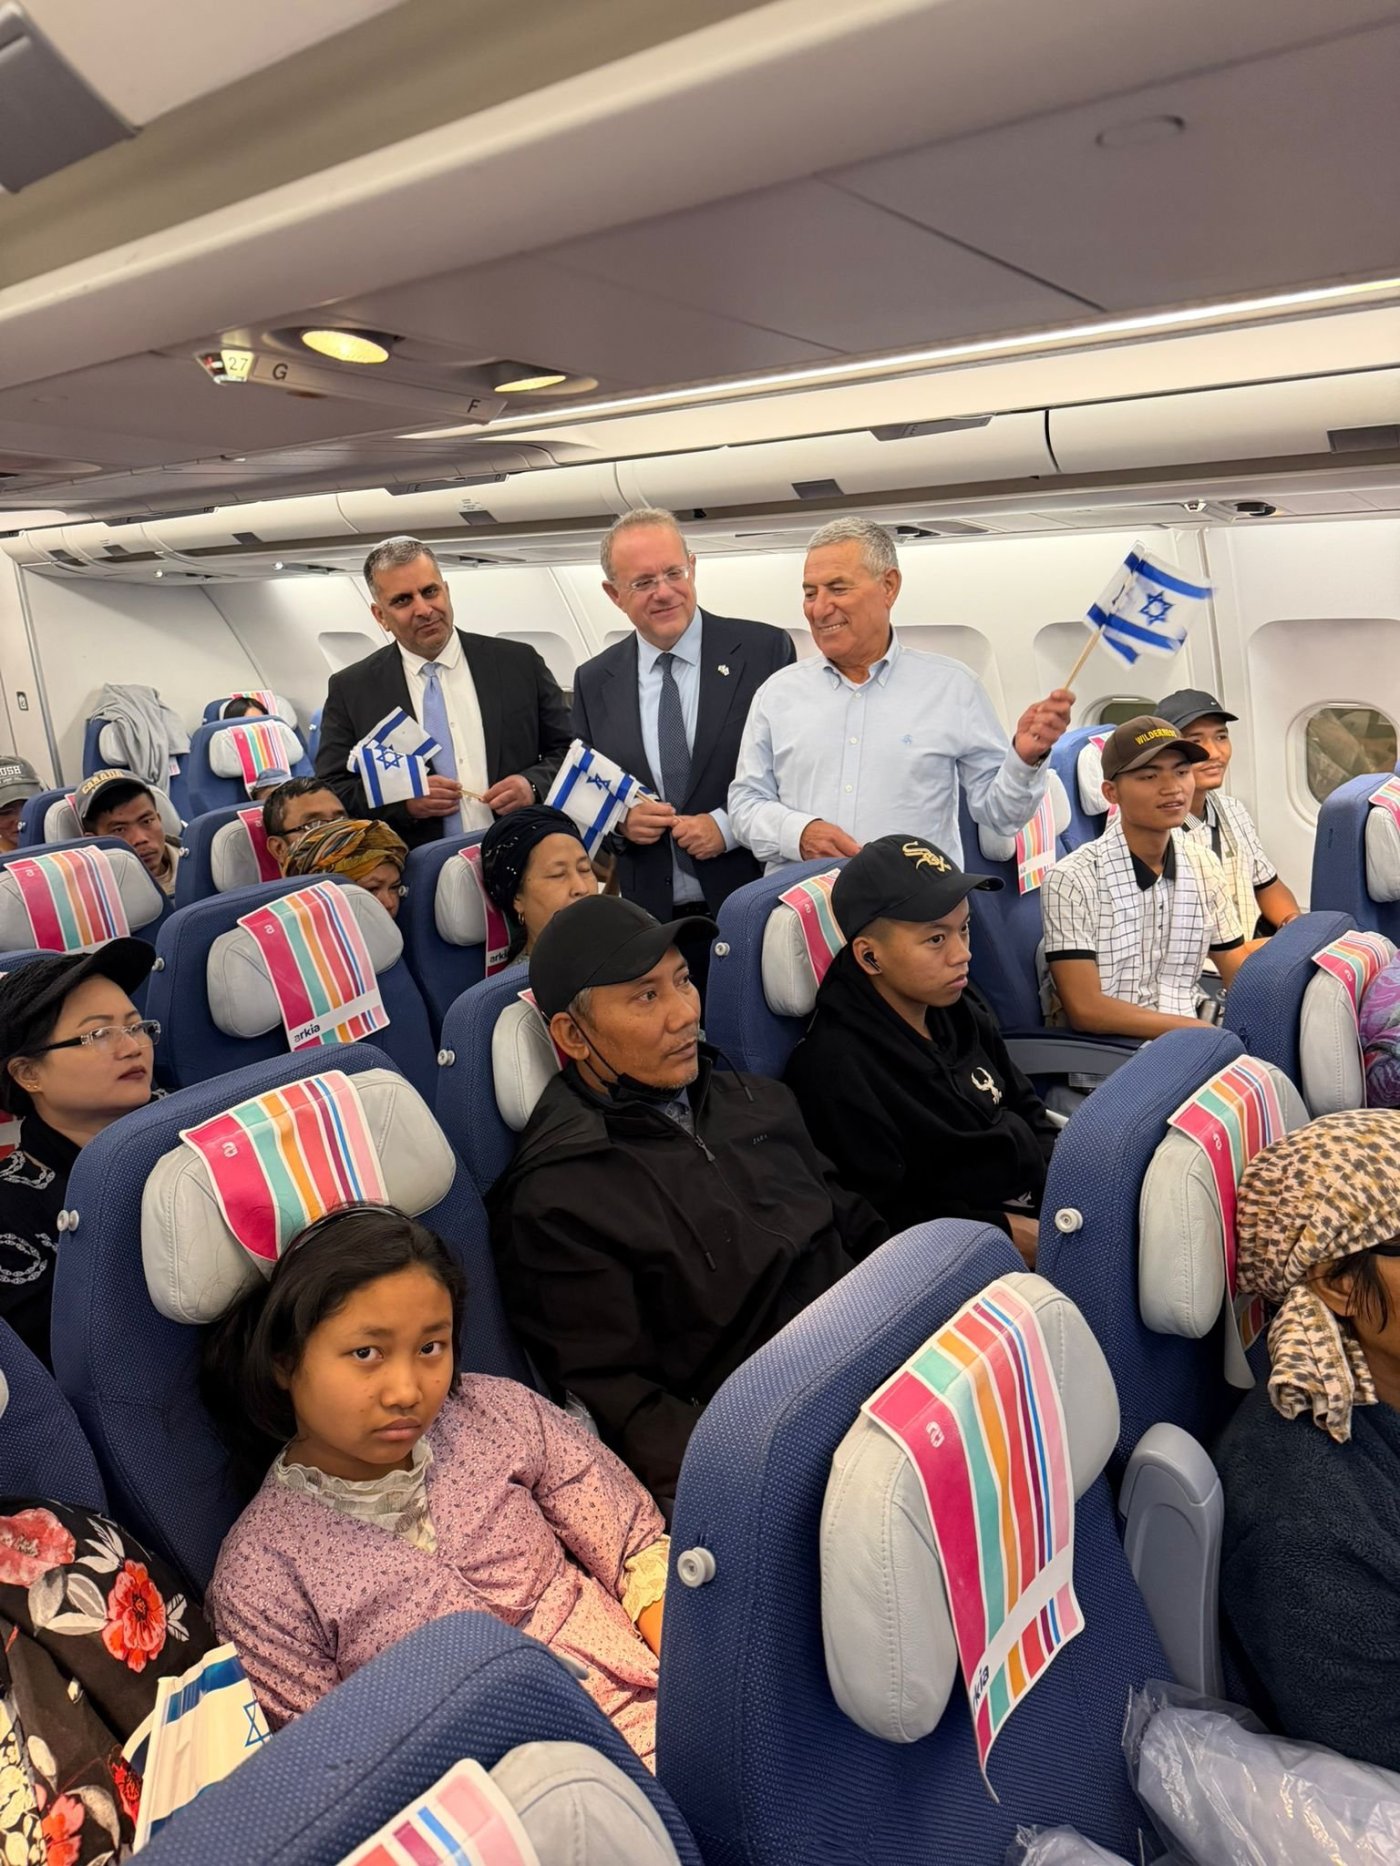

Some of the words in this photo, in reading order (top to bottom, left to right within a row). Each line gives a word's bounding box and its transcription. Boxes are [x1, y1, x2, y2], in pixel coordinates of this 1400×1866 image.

[228, 356, 248, 371] 27
[272, 363, 288, 380] G
[467, 399, 480, 413] F
[0, 766, 21, 776] USH
[490, 949, 508, 962] arki
[294, 1024, 321, 1042] arkia
